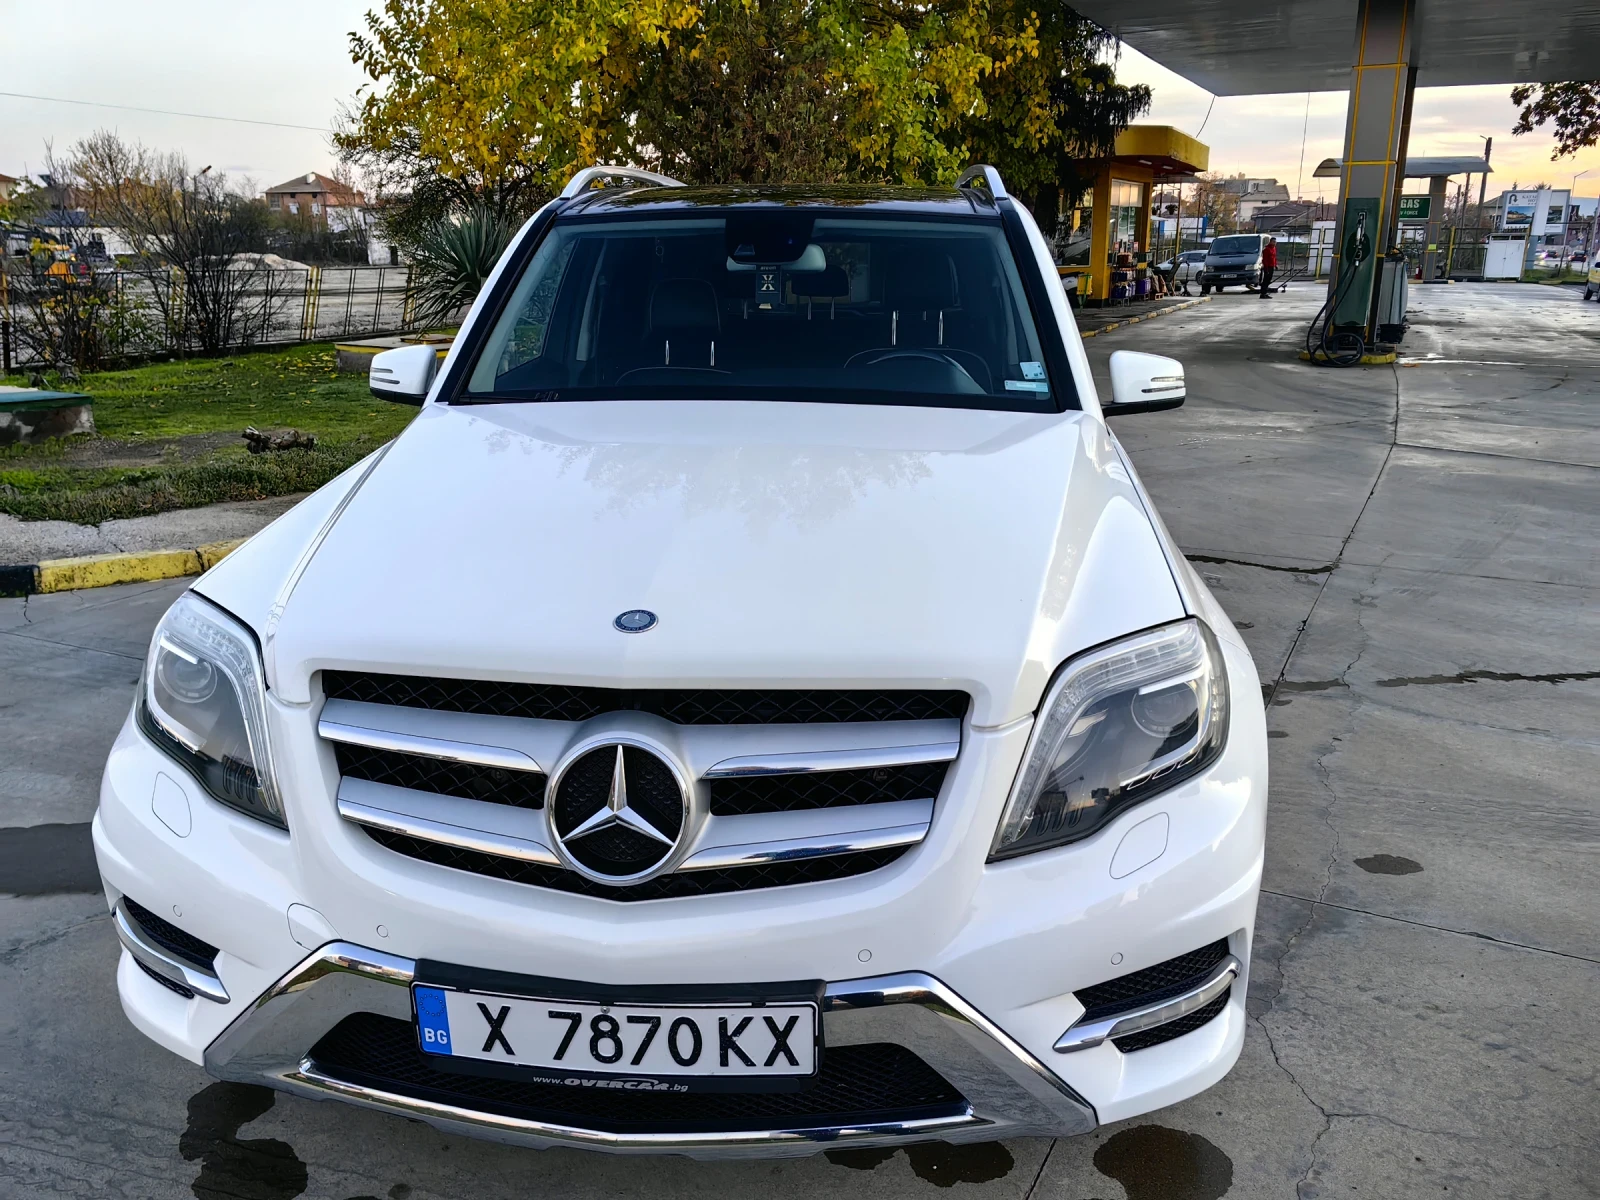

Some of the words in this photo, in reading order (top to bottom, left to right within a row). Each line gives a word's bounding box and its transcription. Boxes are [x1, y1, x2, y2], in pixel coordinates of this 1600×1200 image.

[1400, 199, 1420, 208] GAS
[424, 1027, 448, 1045] BG
[476, 1001, 516, 1056] X
[547, 1010, 703, 1067] 7870
[719, 1015, 800, 1068] KX
[533, 1076, 689, 1092] www.OVERCAR.bg
